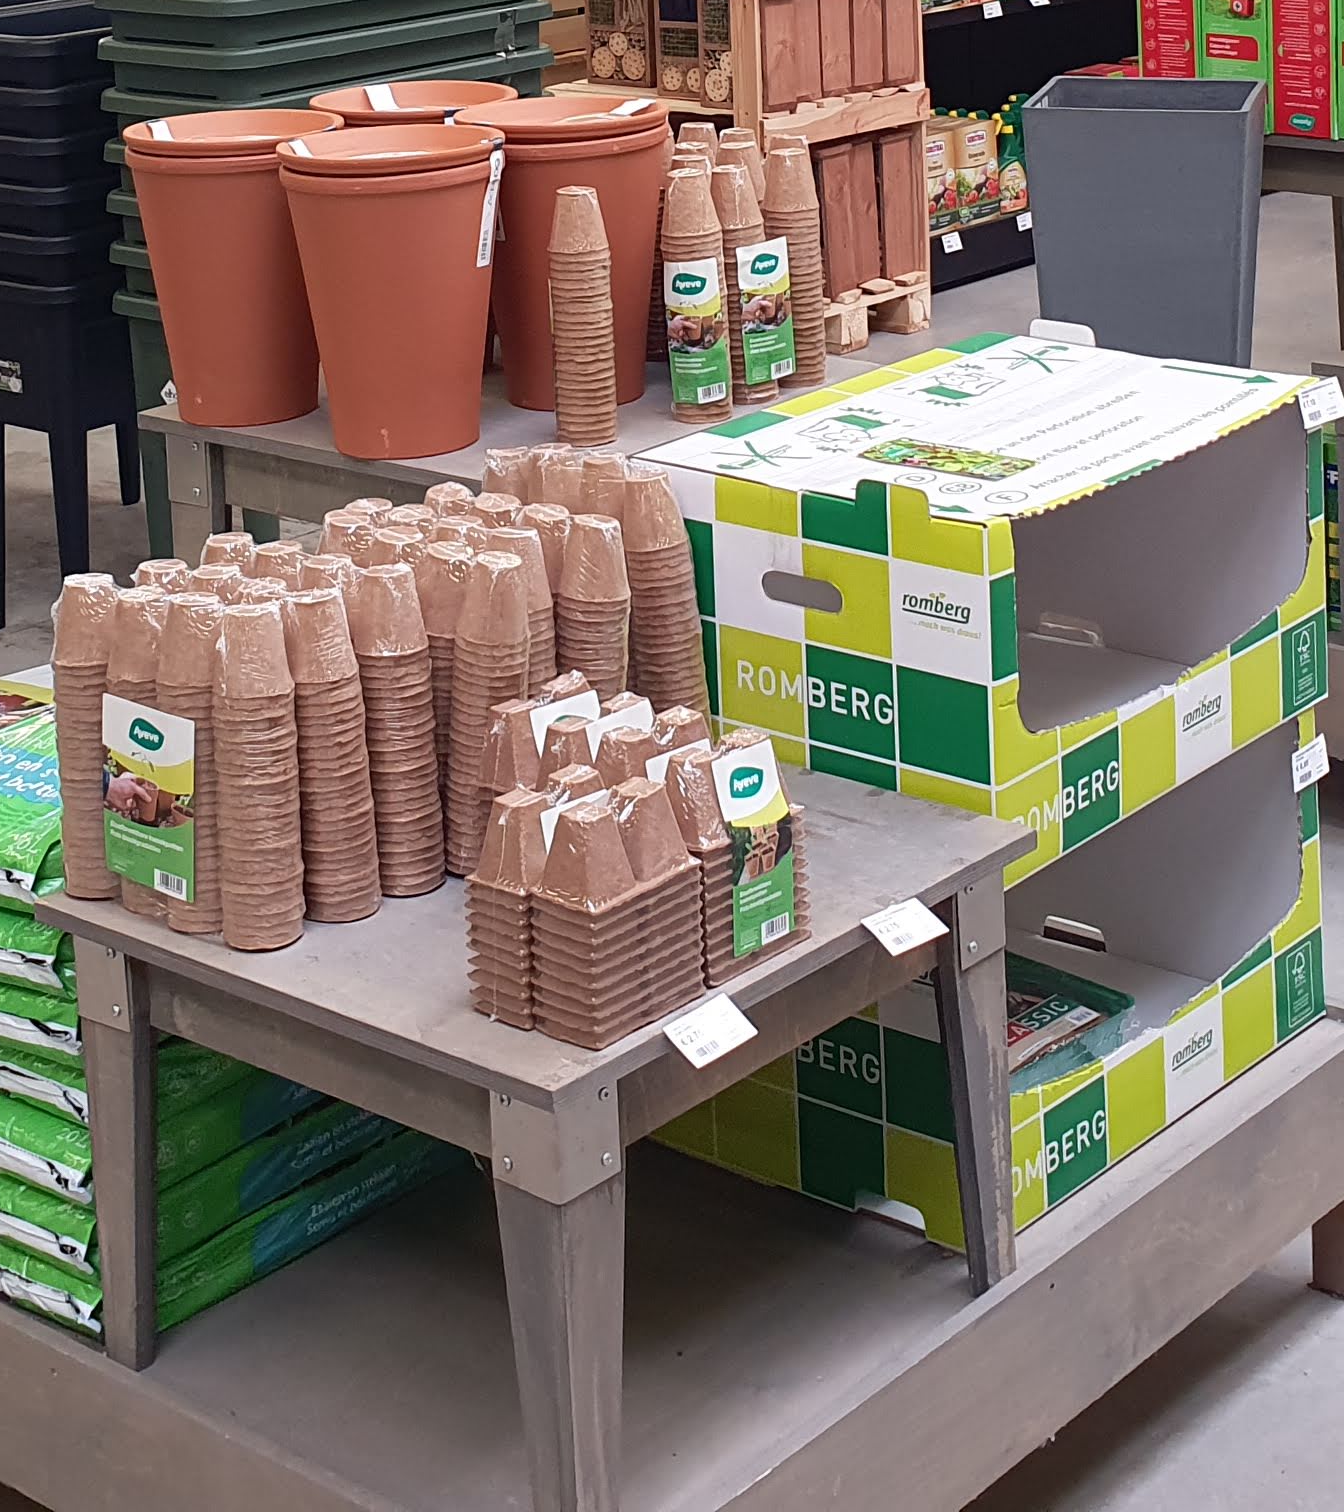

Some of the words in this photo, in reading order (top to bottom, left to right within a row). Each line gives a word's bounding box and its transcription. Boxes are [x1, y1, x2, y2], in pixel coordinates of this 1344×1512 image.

[1029, 469, 1079, 491] Arracher
[1162, 417, 1198, 436] suivant
[902, 591, 971, 622] romberg
[736, 659, 894, 725] ROMBERG
[1181, 694, 1222, 727] romberg
[133, 725, 160, 744] Aveve
[733, 773, 759, 793] Aveve
[1007, 1000, 1070, 1043] LASSIC
[797, 1038, 881, 1085] BERG
[1171, 1028, 1214, 1061] romberg
[1012, 1109, 1106, 1199] OMBERG
